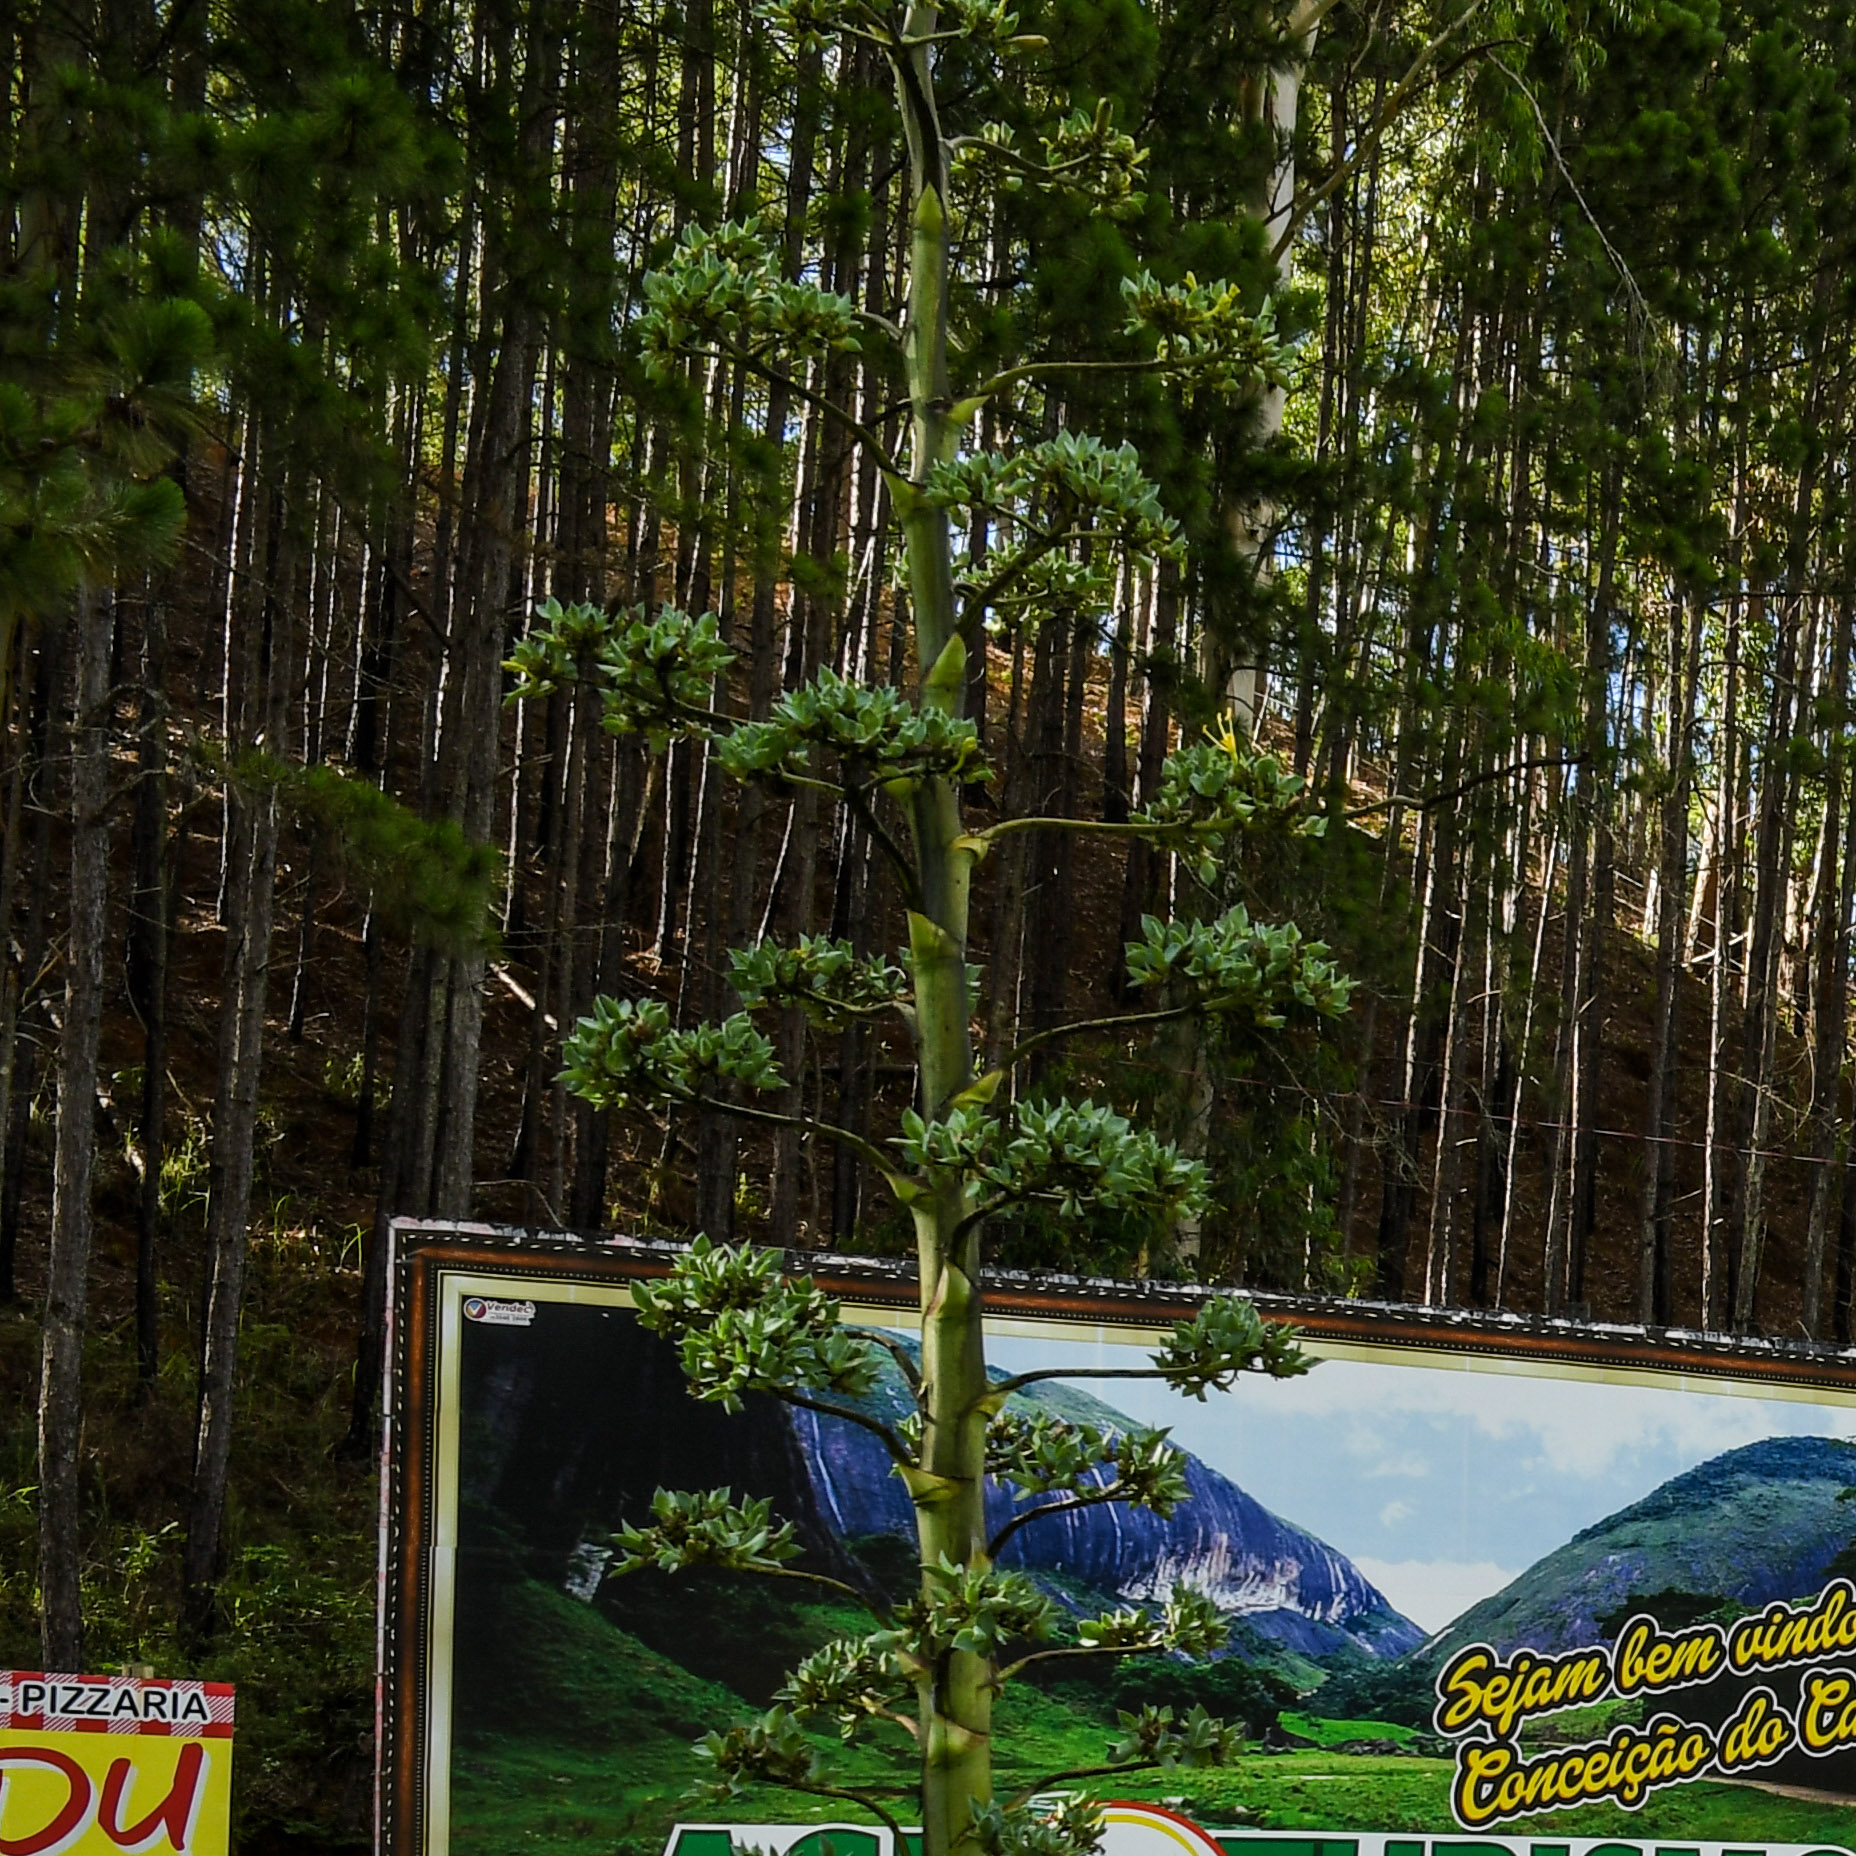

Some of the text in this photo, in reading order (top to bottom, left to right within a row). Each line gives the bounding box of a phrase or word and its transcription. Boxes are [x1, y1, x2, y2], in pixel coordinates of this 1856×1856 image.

[22, 1683, 208, 1720] PIZZARIA
[1443, 1654, 1606, 1741] Sejam
[1614, 1625, 1720, 1690] bem
[1461, 1723, 1710, 1823] Conceição
[1722, 1697, 1789, 1765] do
